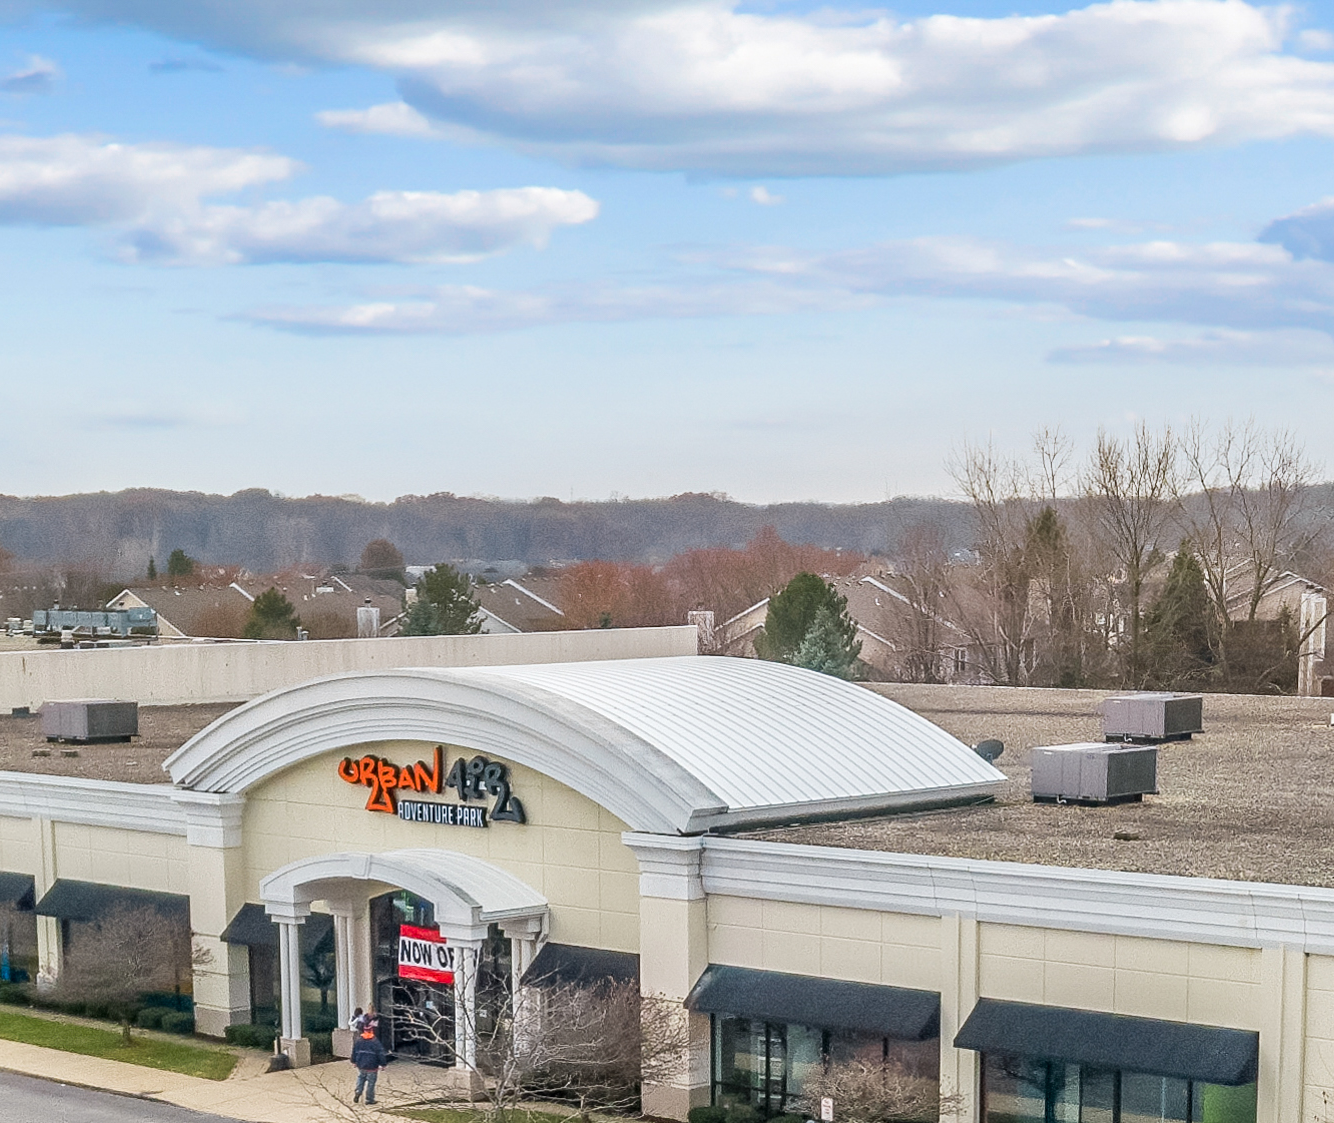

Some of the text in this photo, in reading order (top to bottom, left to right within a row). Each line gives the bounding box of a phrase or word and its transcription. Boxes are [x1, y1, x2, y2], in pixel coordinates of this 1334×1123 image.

[338, 745, 444, 815] URBAN
[398, 800, 485, 828] ADVENTURE PARK
[400, 939, 433, 967] NOW
